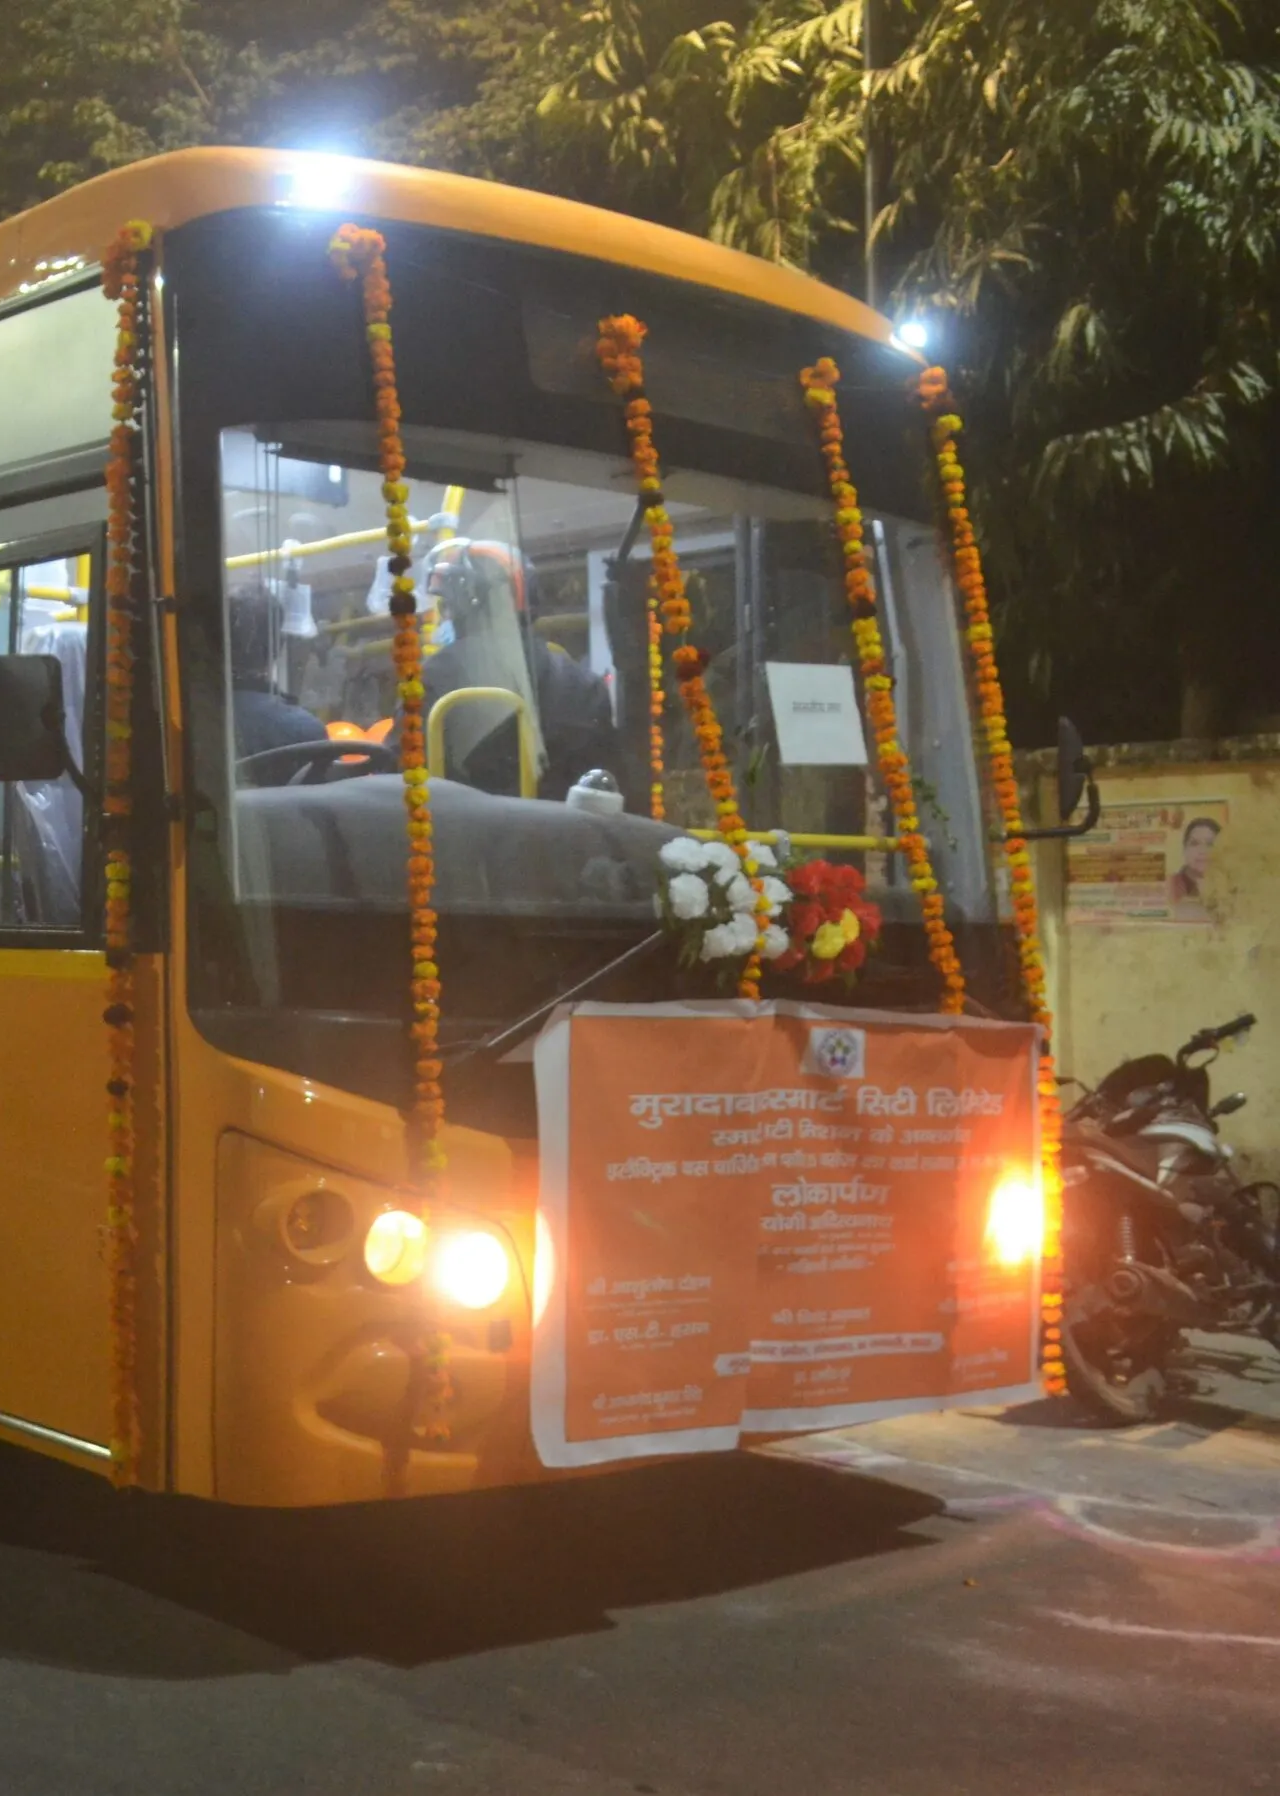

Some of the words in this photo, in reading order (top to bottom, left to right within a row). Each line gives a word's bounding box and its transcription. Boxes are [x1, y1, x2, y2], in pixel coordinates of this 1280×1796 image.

[856, 1085, 919, 1115] सिटी
[770, 1174, 892, 1207] लोकार्पण
[760, 1211, 807, 1231] योगी
